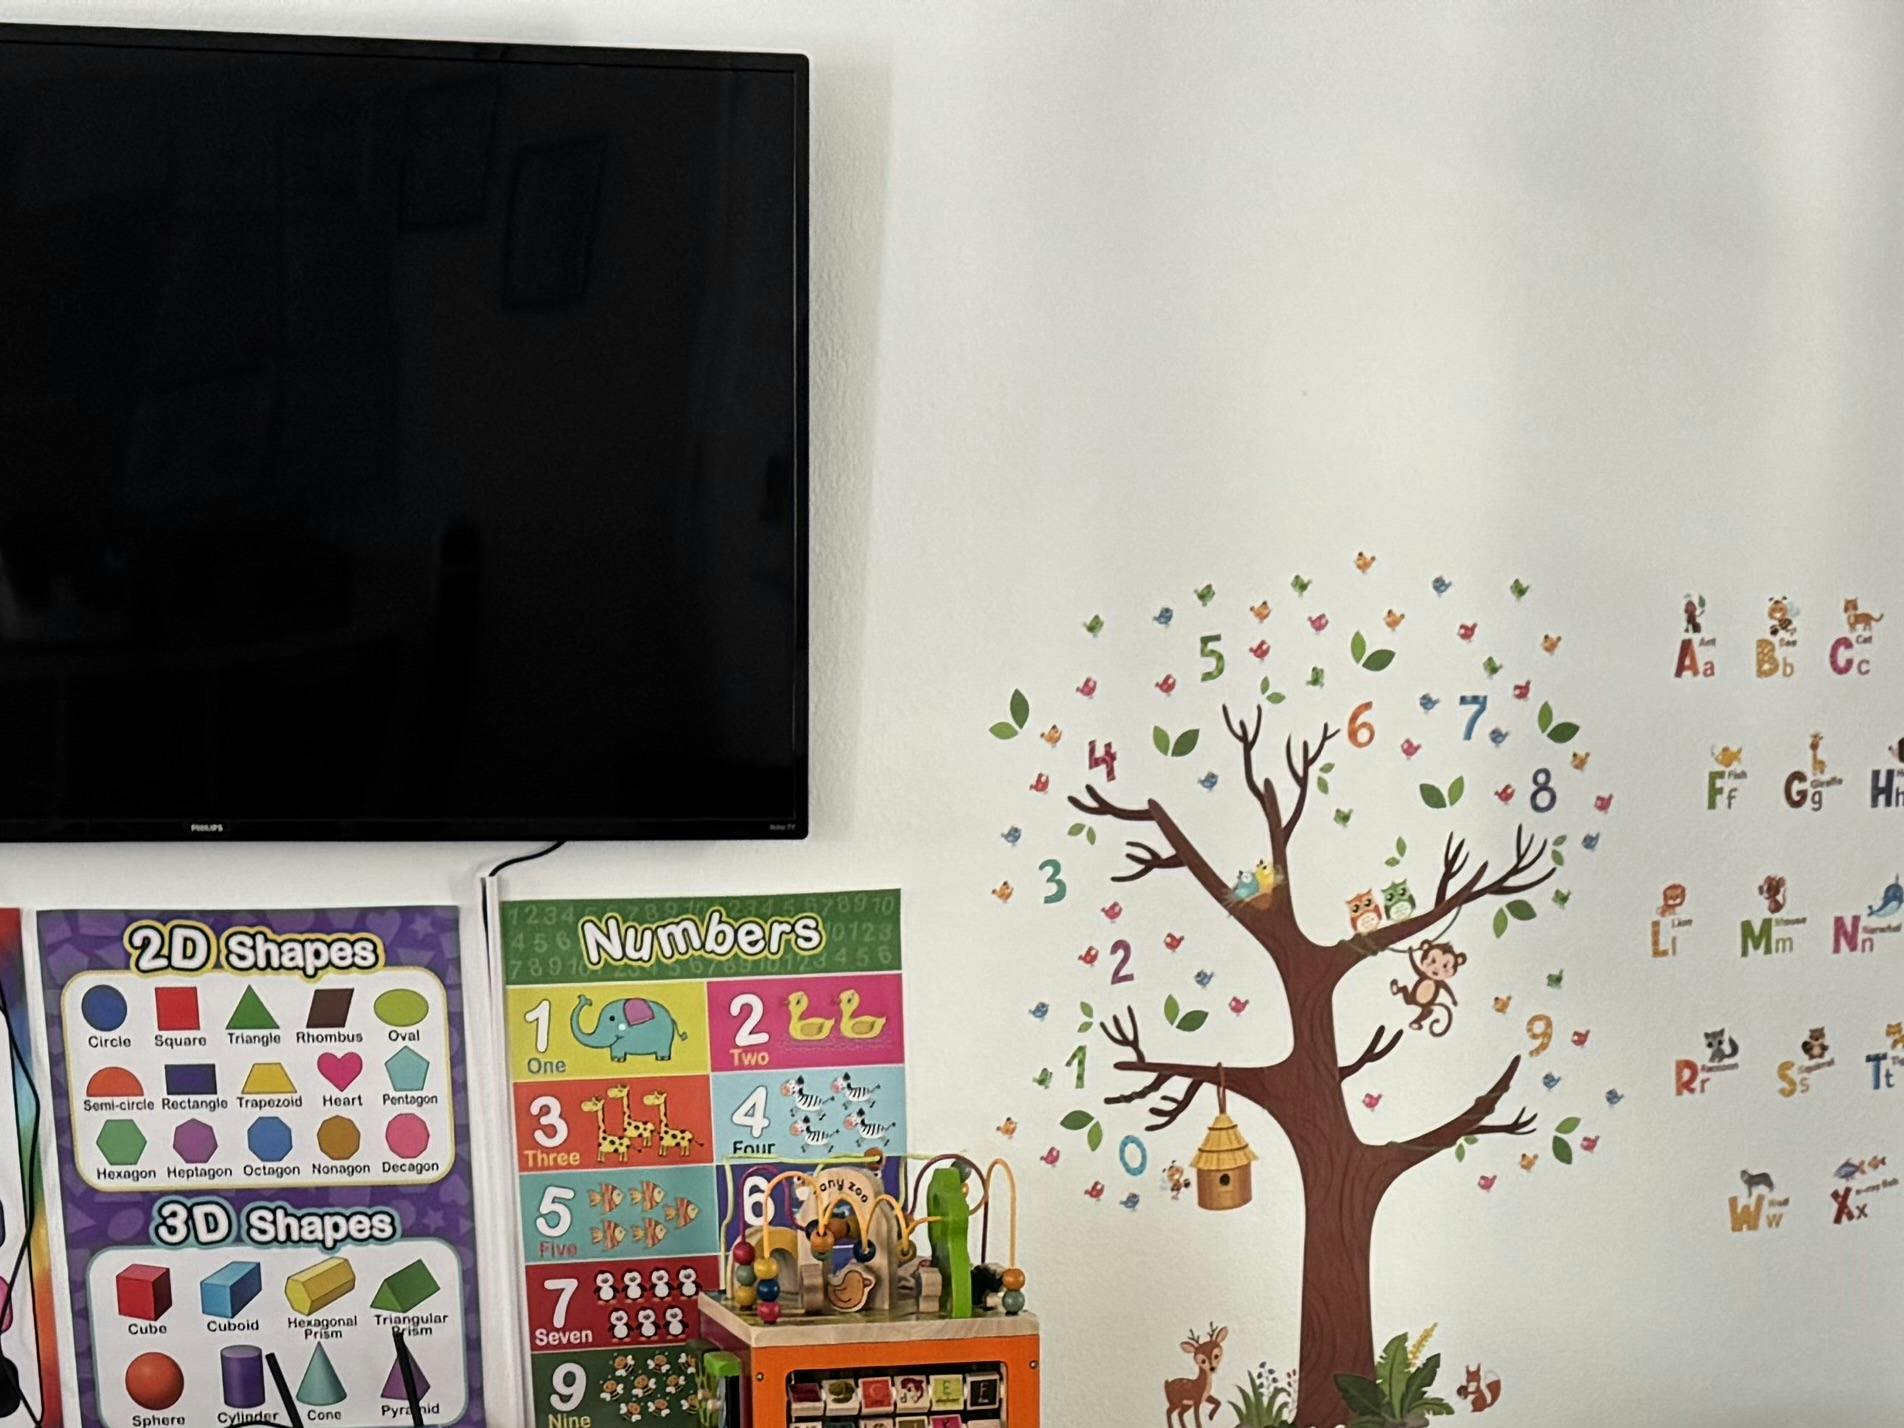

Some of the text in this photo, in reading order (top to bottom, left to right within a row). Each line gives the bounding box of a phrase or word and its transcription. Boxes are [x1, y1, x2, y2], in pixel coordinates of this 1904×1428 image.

[1200, 634, 1226, 682] 5
[1347, 702, 1375, 748] 6
[1460, 695, 1488, 741] 7
[1088, 741, 1117, 781] 4
[1529, 768, 1557, 813] 8
[1039, 859, 1067, 904] 3
[580, 909, 822, 965] Numbers
[129, 925, 378, 977] 2D Shapes
[1110, 939, 1134, 986] 2
[525, 1000, 550, 1053] 1
[729, 993, 770, 1047] 2
[88, 1035, 131, 1048] Circle
[154, 1034, 206, 1048] Square
[228, 1032, 281, 1046] Triangle
[296, 1031, 363, 1044] Rhombus
[388, 1030, 420, 1042] Oval
[1527, 1014, 1553, 1057] 9
[730, 1049, 770, 1067] Two
[527, 1058, 566, 1074] One
[1065, 1045, 1088, 1089] 1
[83, 1098, 154, 1112] Semi-circle
[161, 1097, 228, 1112] Rectangle
[237, 1095, 302, 1110] Trapezoid
[322, 1094, 363, 1107] Heart
[382, 1093, 438, 1107] Pentagon
[731, 1086, 770, 1138] 4
[530, 1096, 569, 1148] 3
[733, 1141, 776, 1155] Four
[524, 1149, 580, 1167] Three
[97, 1167, 156, 1181] Hexagon
[167, 1165, 233, 1179] Heptagon
[243, 1164, 300, 1177] Octagon
[312, 1162, 370, 1175] Nonagon
[382, 1161, 439, 1174] Decagon
[848, 1181, 868, 1203] zoo
[743, 1176, 774, 1226] 6
[536, 1186, 576, 1238] 5
[157, 1200, 395, 1250] 3D Shapes
[538, 1242, 578, 1257] Five
[543, 1279, 579, 1329] 7
[207, 1320, 259, 1333] Cuboid
[287, 1316, 358, 1329] Hexagonal
[374, 1313, 448, 1327] Triangular
[128, 1323, 167, 1335] Cube
[304, 1328, 343, 1340] Prism
[536, 1329, 593, 1346] Seven
[550, 1362, 587, 1412] 9
[132, 1415, 185, 1428] Sphere
[217, 1411, 280, 1425] Cylinder
[307, 1410, 341, 1421] Cone
